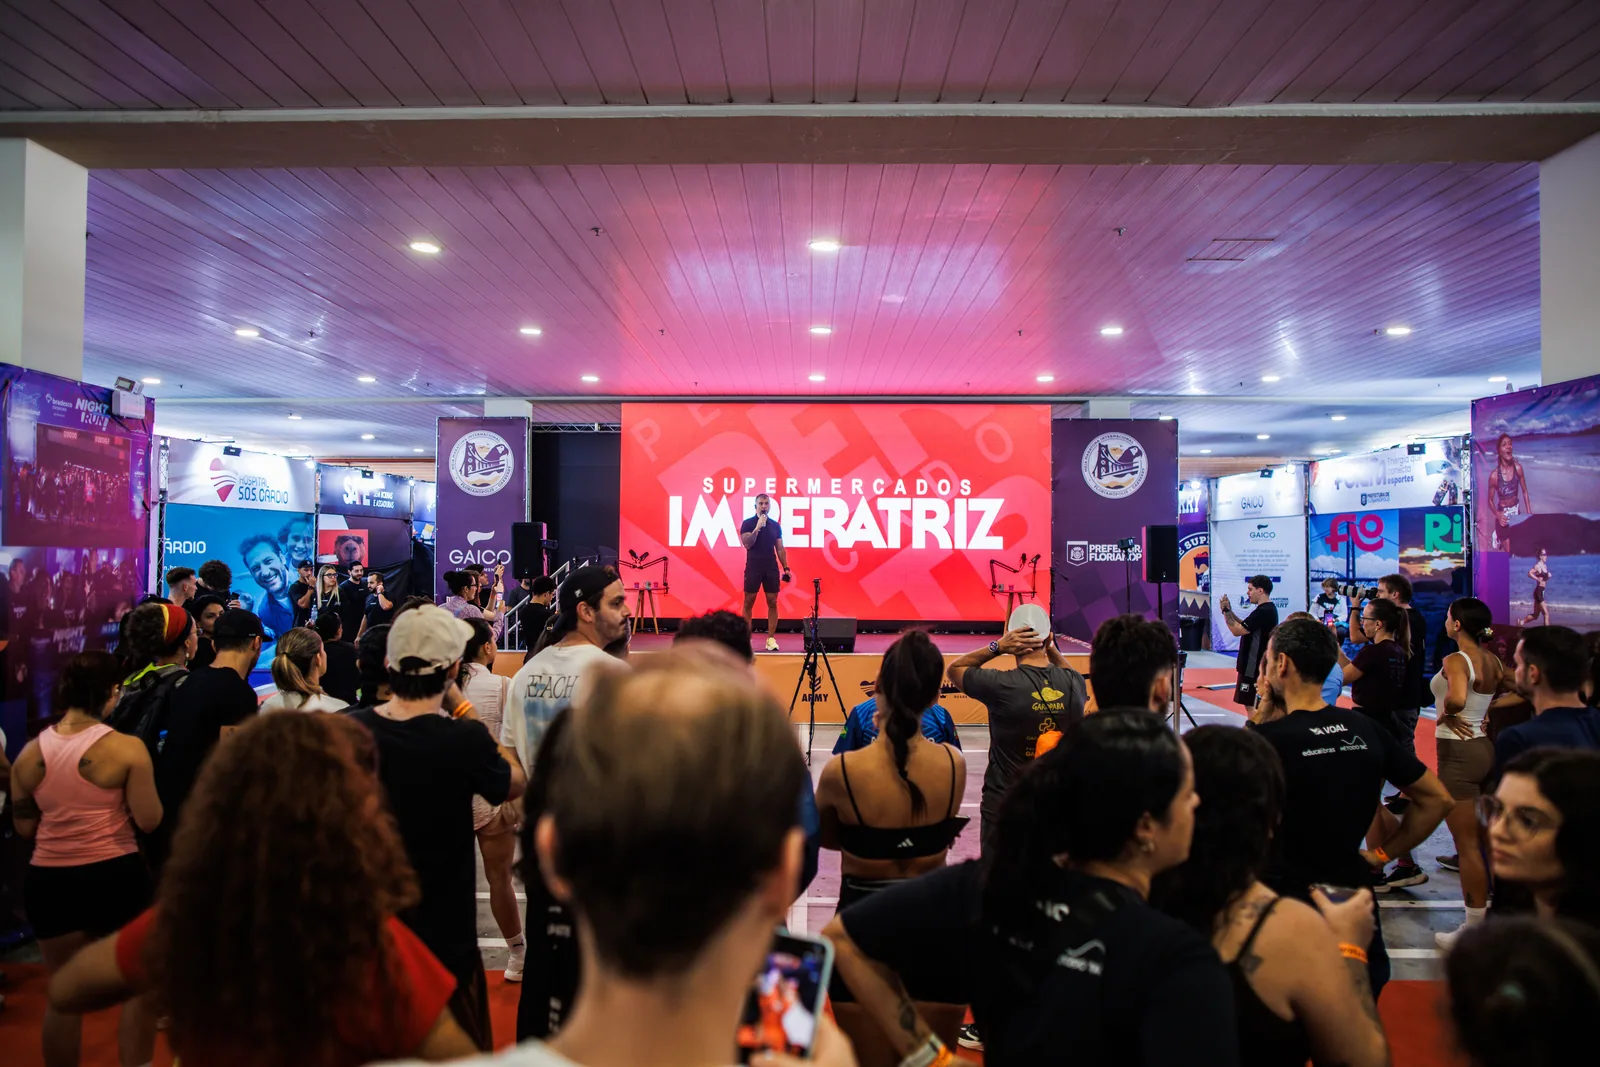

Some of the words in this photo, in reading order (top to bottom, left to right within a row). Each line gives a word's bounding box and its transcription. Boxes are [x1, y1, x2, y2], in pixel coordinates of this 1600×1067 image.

[75, 397, 109, 414] NIGHT
[702, 477, 973, 496] SUPERMERCADOS
[1387, 474, 1414, 487] esportes
[1249, 531, 1276, 539] GAICO
[1089, 544, 1142, 553] PREFEUR
[449, 549, 511, 565] GAICO
[1324, 723, 1349, 735] VOAL
